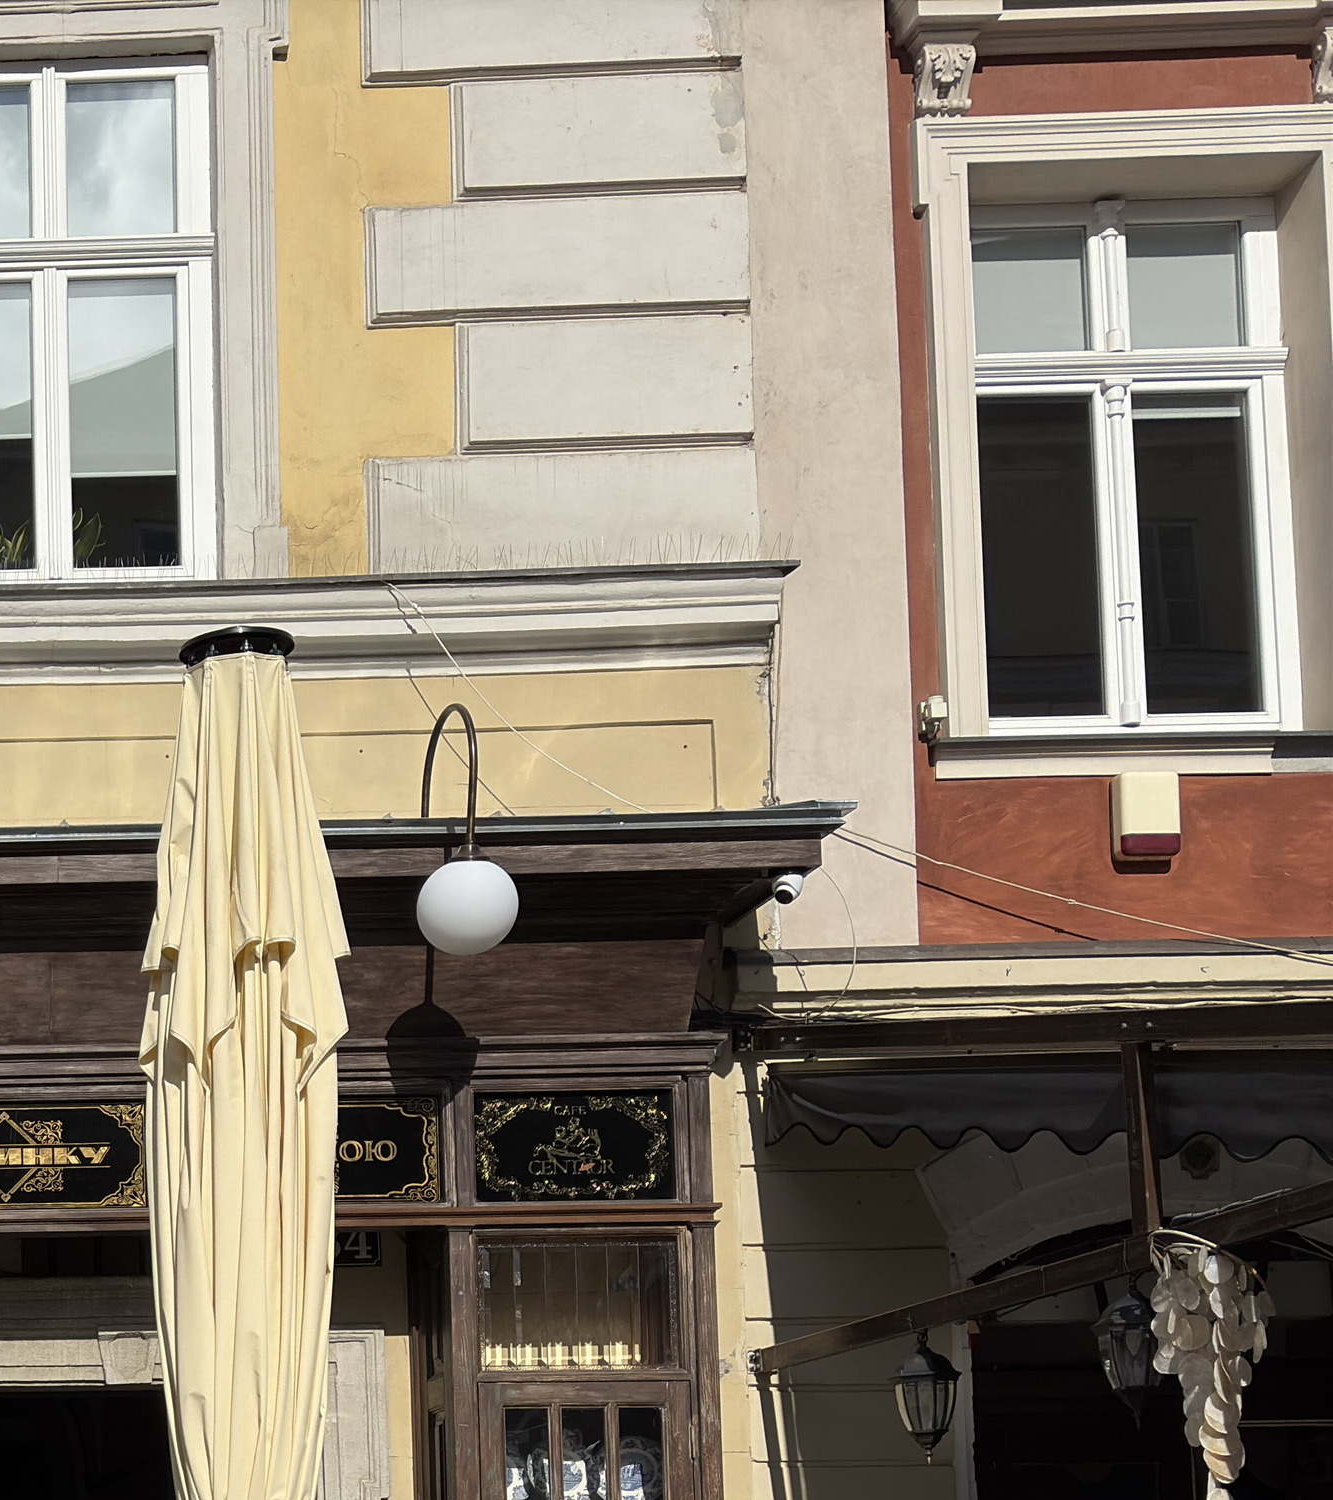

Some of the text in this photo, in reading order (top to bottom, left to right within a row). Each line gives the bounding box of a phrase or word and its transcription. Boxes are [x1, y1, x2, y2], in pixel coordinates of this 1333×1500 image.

[553, 1105, 587, 1116] CAFE
[335, 1139, 398, 1162] ОЮ
[528, 1157, 617, 1176] CENTAUR
